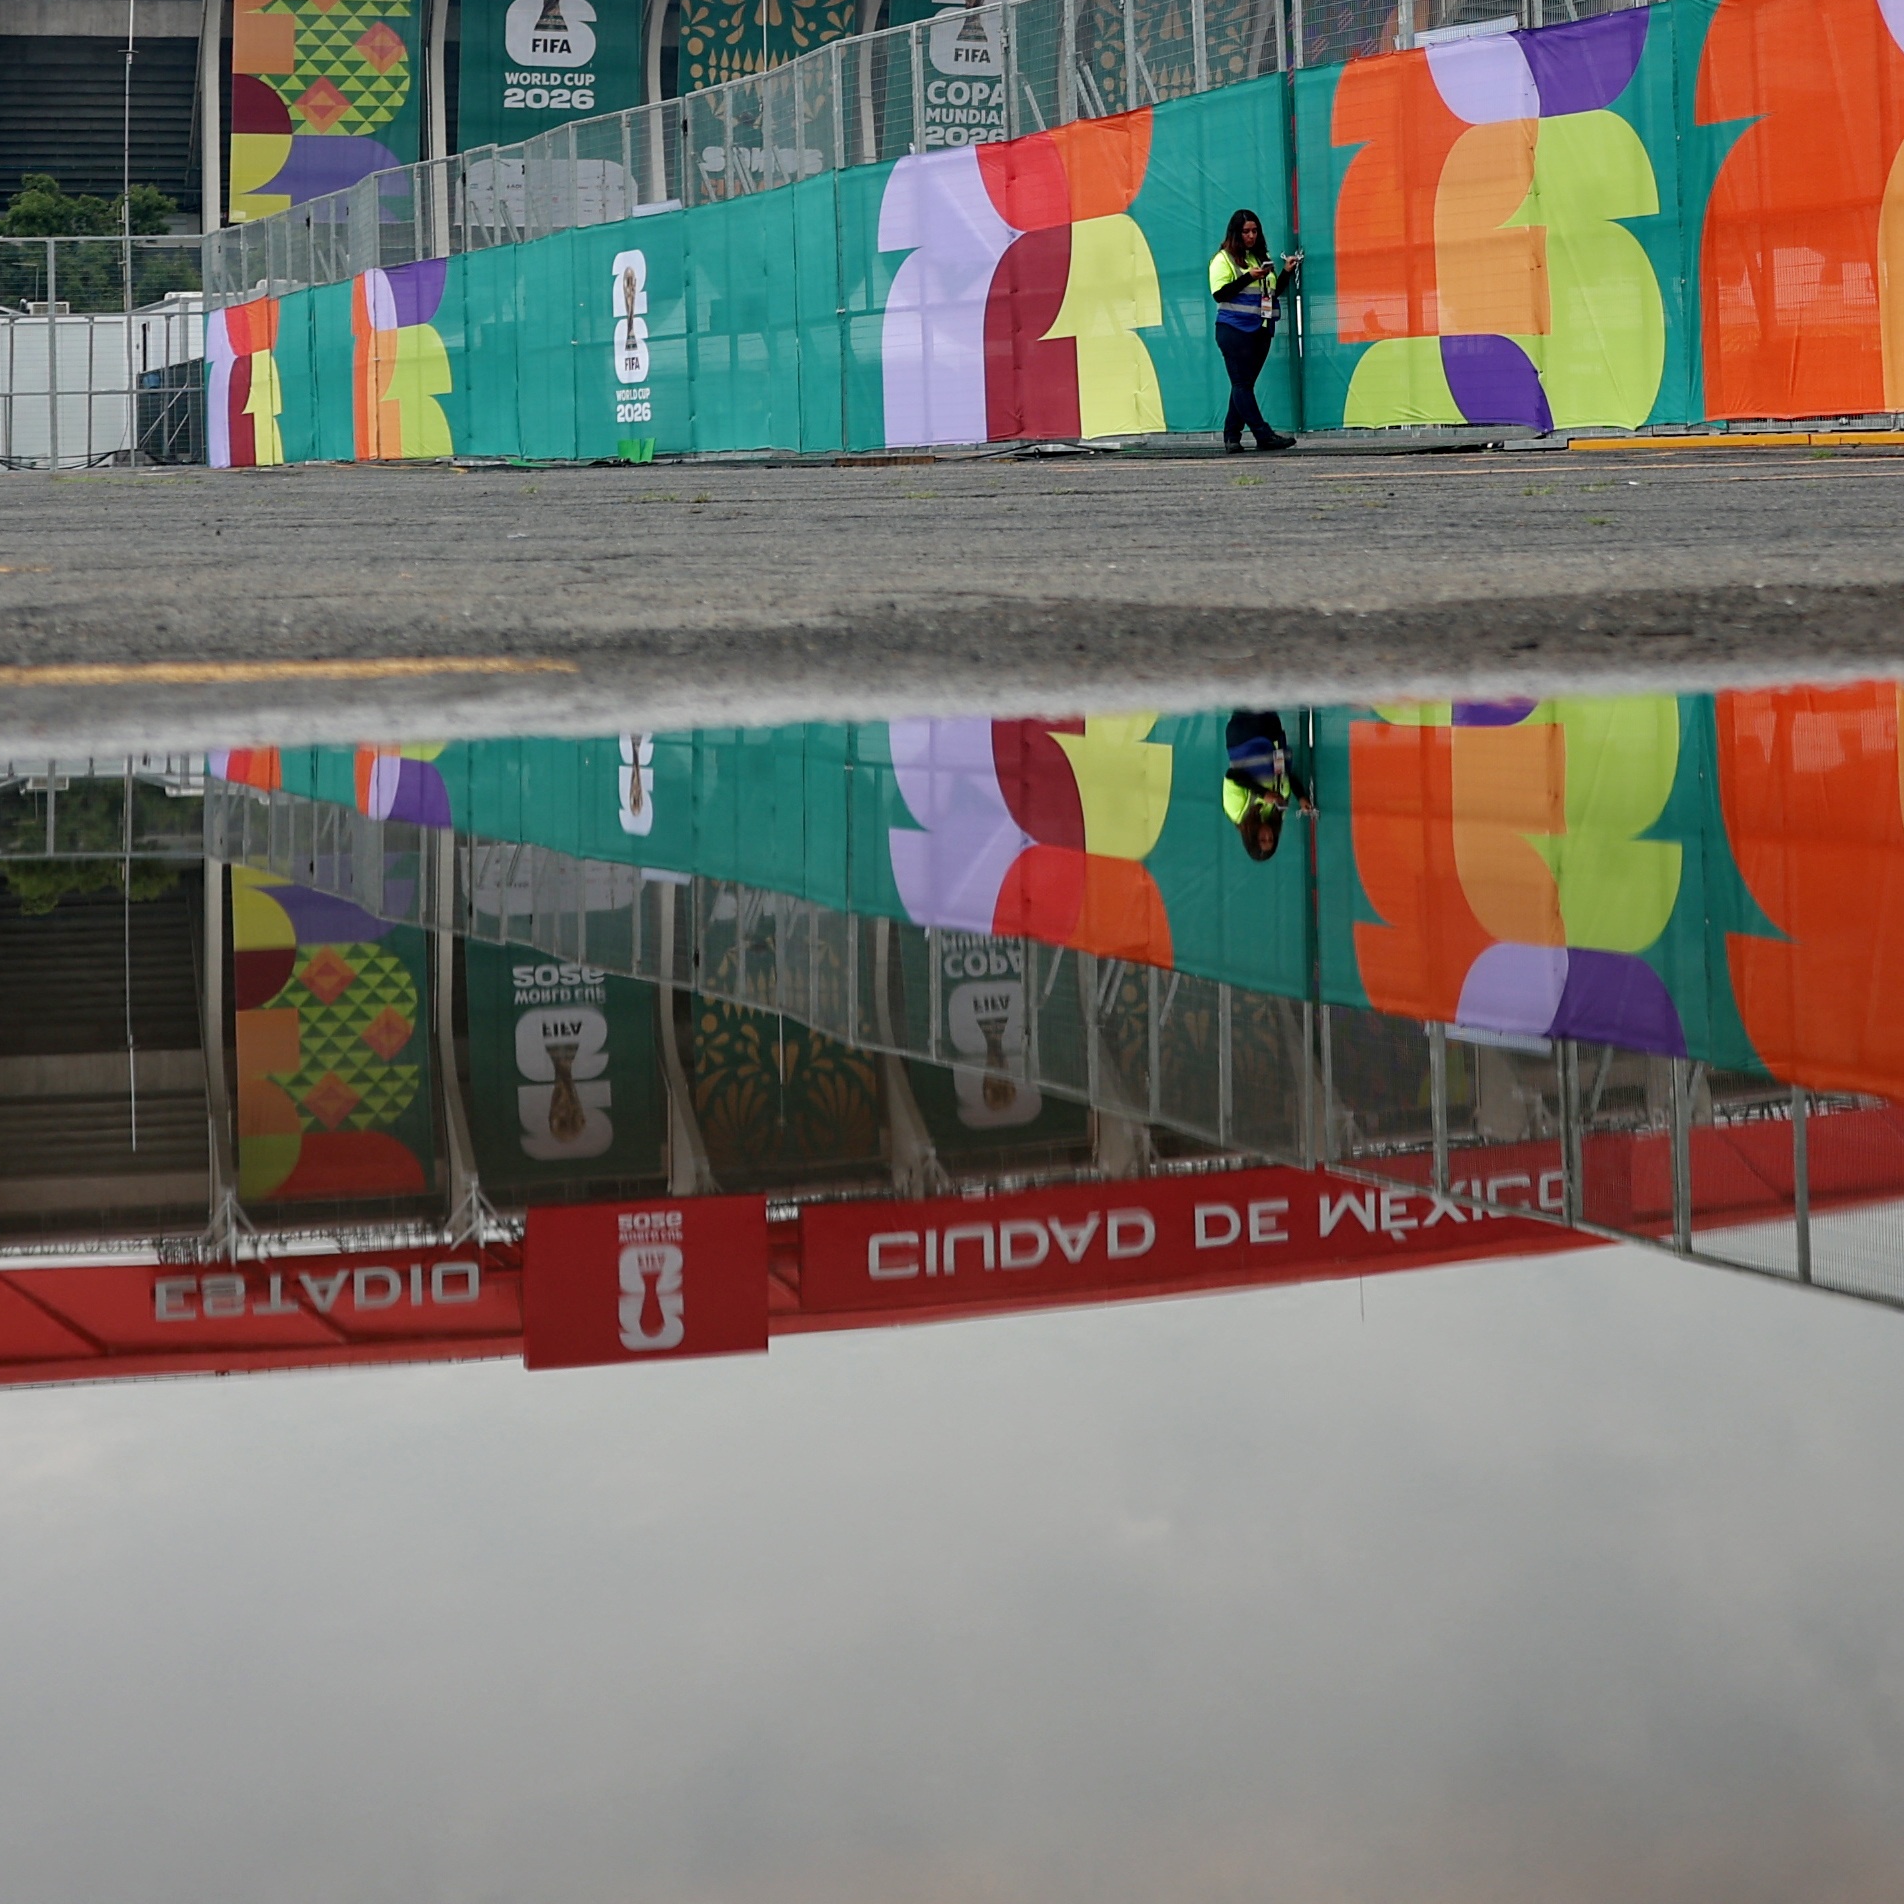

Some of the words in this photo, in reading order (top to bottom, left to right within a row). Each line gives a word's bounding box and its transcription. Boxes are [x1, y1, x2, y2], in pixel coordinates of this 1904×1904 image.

[531, 38, 572, 54] FIFA
[954, 47, 991, 64] FIFA
[505, 72, 561, 86] WORLD
[564, 73, 595, 87] CUP
[504, 88, 595, 110] 2026
[927, 80, 1005, 106] COPA
[624, 356, 641, 371] FIFA
[616, 389, 637, 401] WORLD
[638, 388, 650, 400] CUP
[616, 402, 651, 422] 2026
